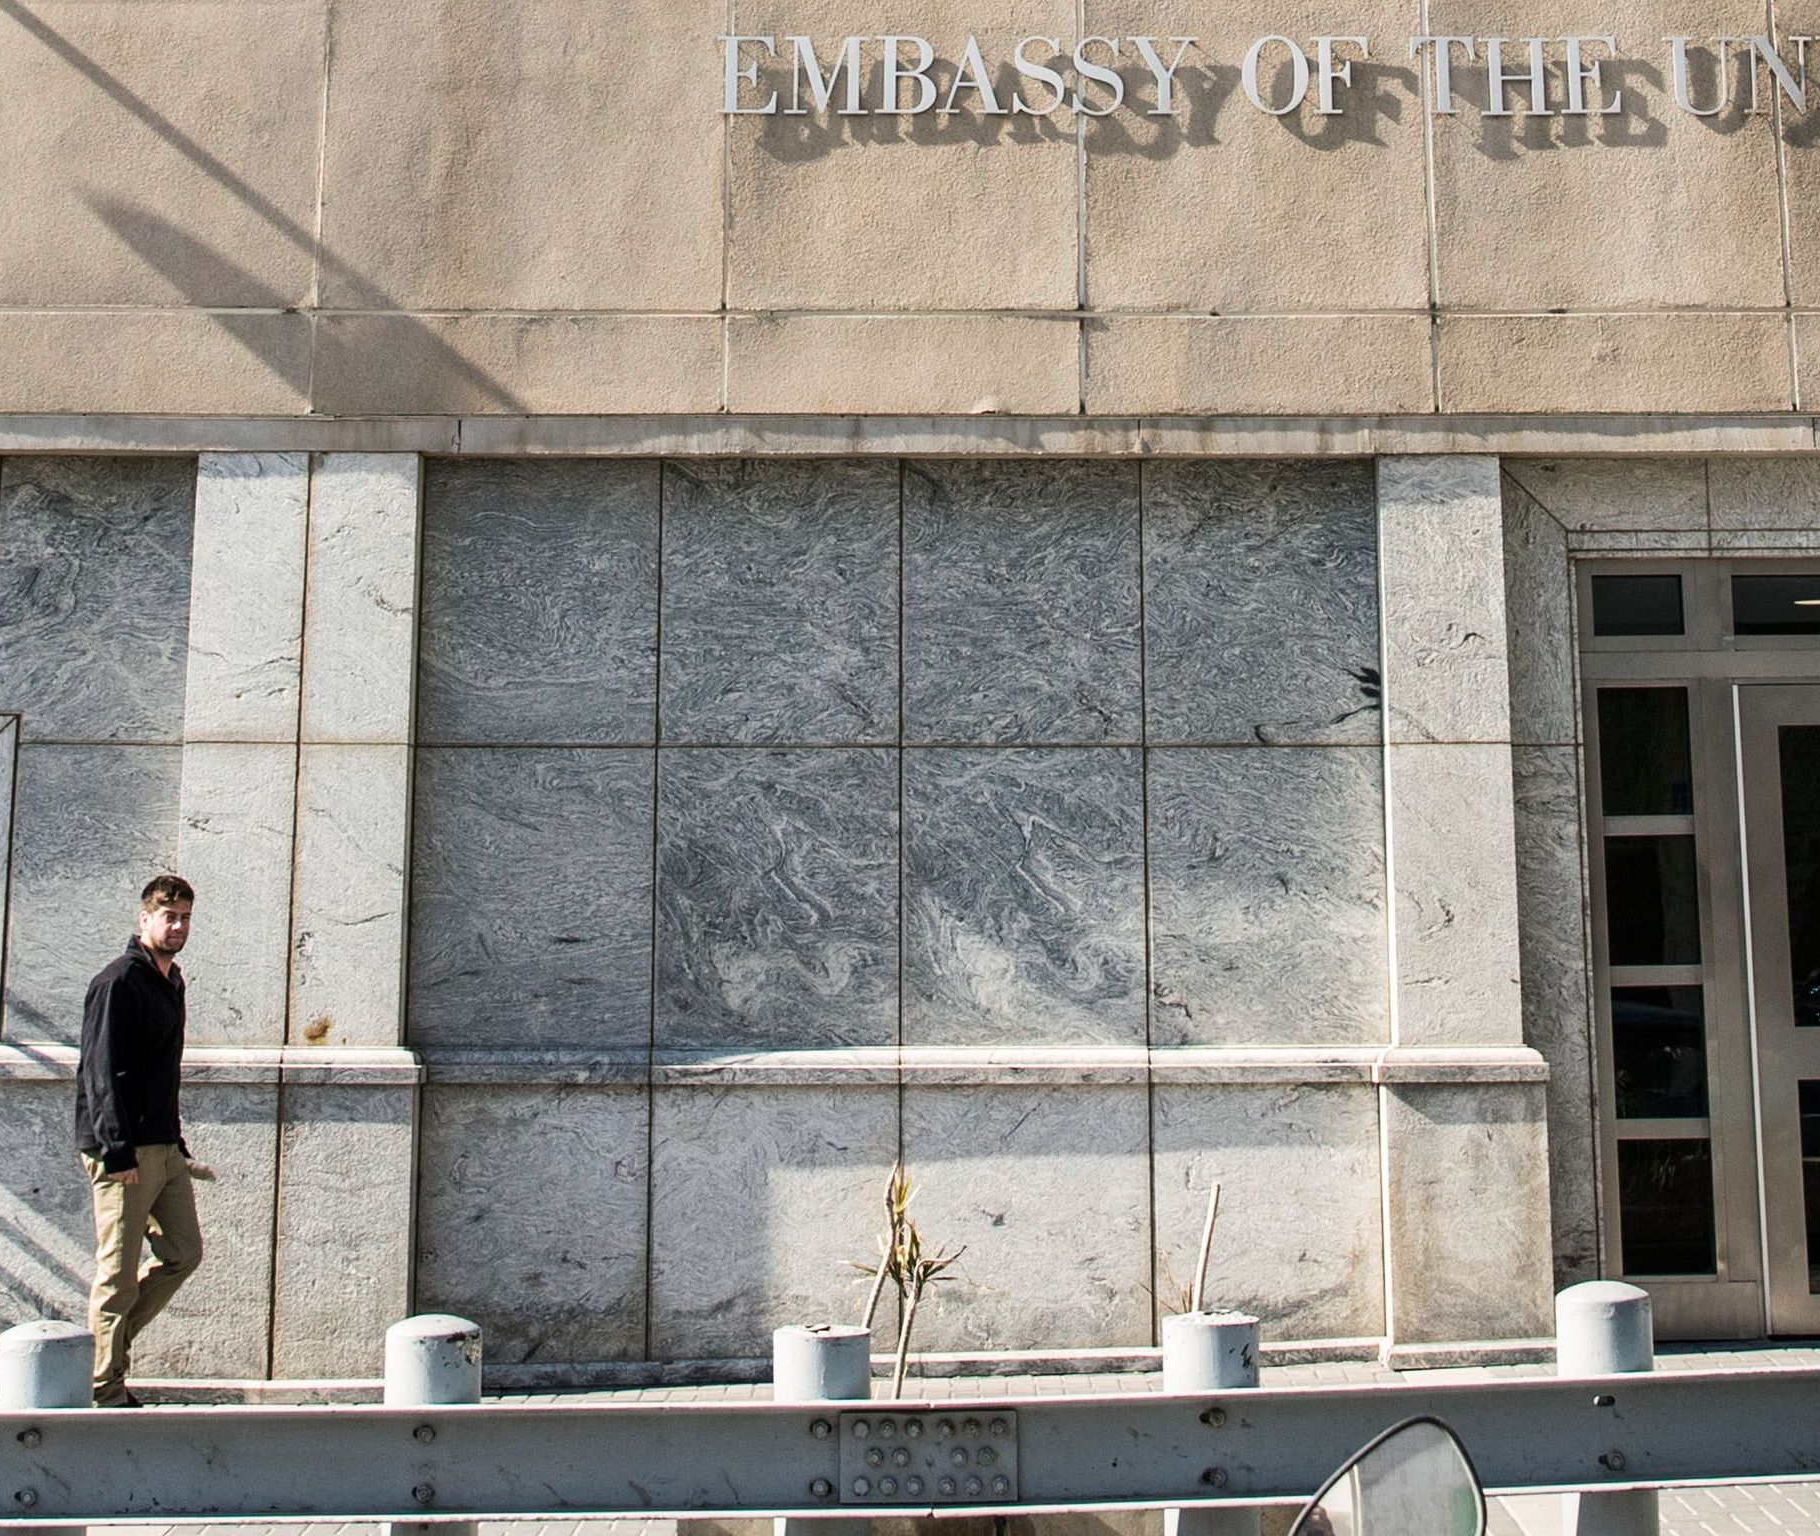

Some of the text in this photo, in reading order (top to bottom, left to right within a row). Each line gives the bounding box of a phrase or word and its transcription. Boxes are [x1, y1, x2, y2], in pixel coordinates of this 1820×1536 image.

[717, 34, 1199, 117] EMBASSY
[1241, 34, 1369, 116] OF
[1409, 35, 1622, 116] THE
